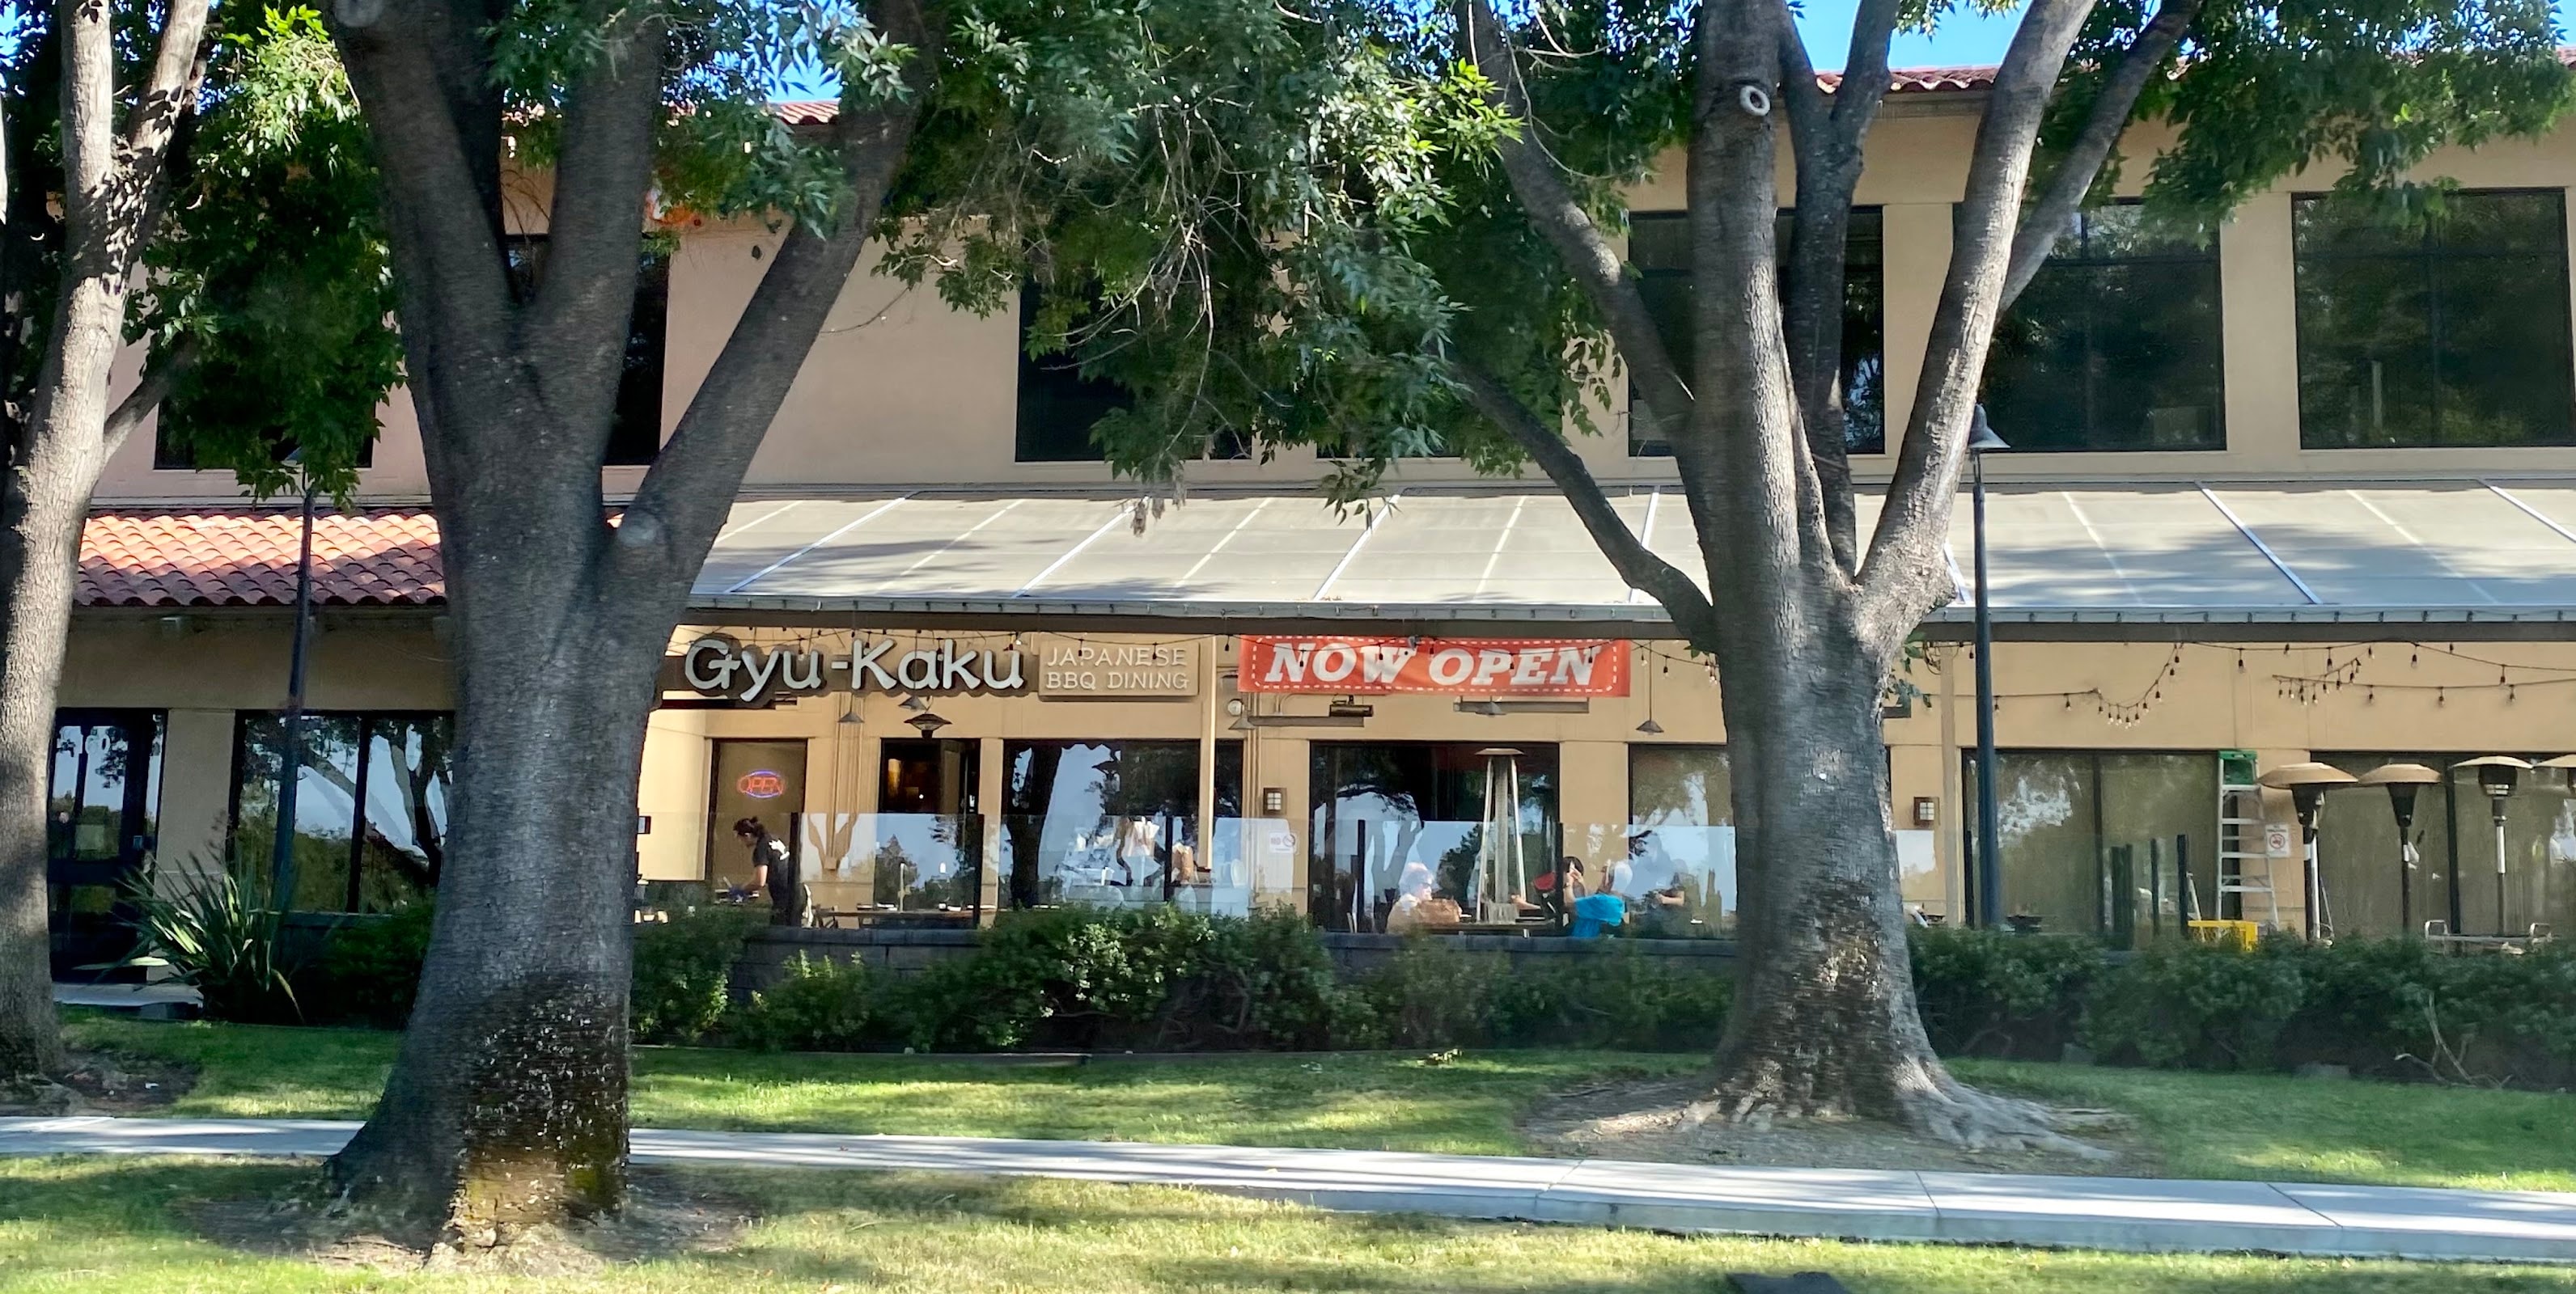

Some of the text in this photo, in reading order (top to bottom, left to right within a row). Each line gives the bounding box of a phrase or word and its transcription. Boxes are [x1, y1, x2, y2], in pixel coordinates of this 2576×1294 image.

[1047, 647, 1188, 666] JAPANESE
[1264, 642, 1601, 686] NOW OPEN
[684, 639, 1025, 702] Gyu-Kaku
[1046, 671, 1189, 690] BBQ DINING
[737, 776, 784, 795] OPEN
